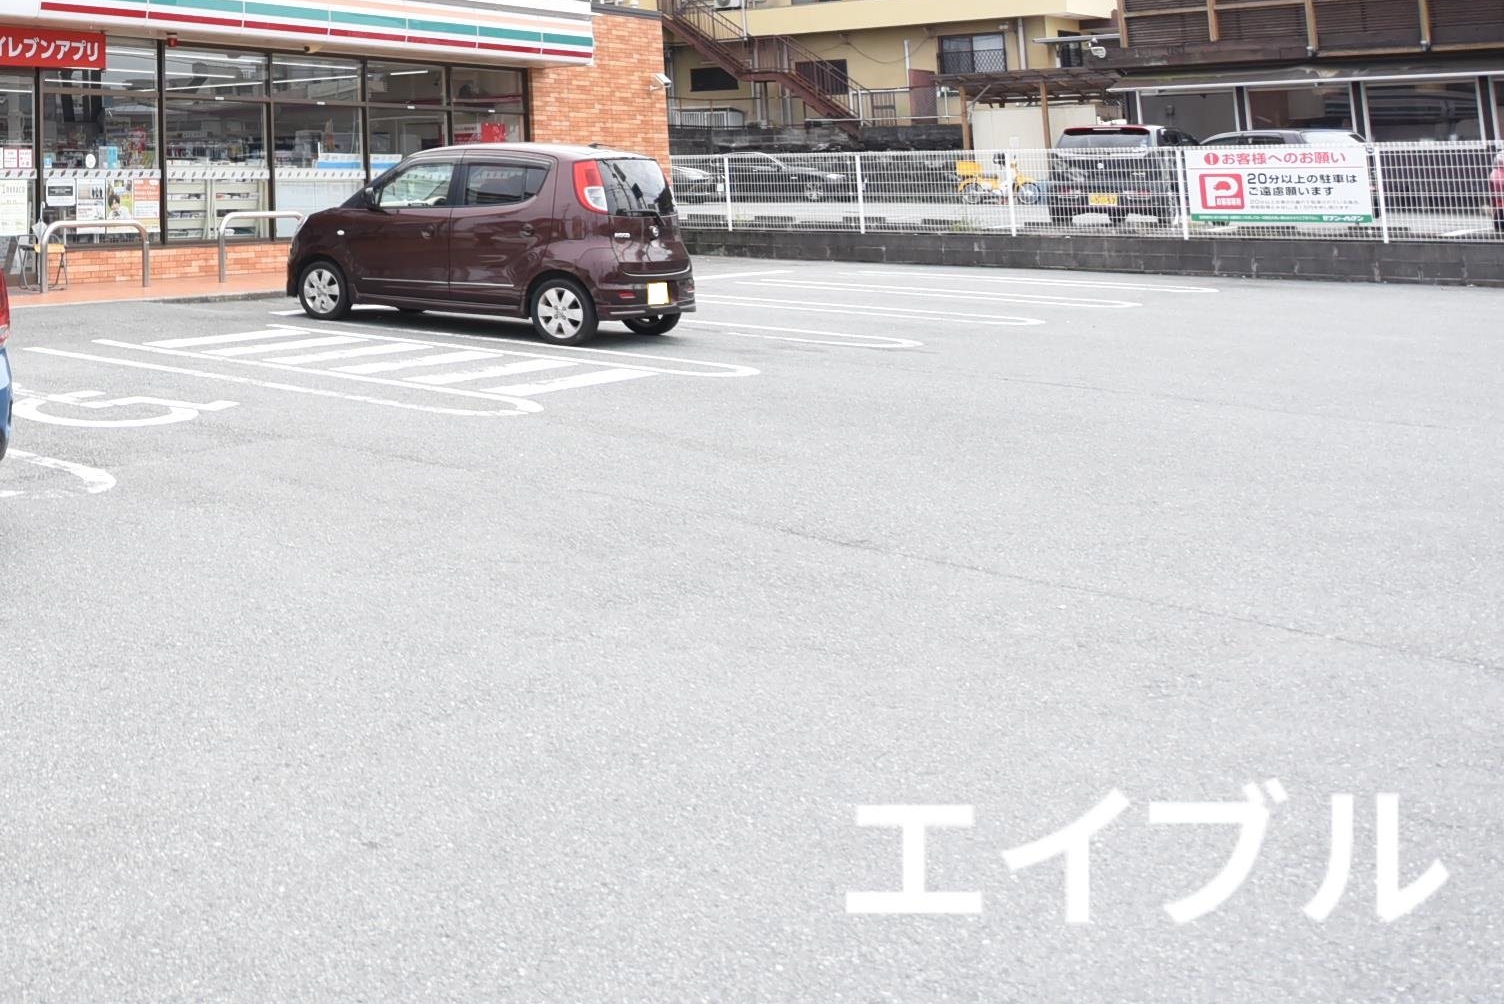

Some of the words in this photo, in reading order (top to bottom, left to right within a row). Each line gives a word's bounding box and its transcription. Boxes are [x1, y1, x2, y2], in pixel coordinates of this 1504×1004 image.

[1222, 151, 1347, 165] お客様へのお願い
[1247, 173, 1358, 184] 20分以上の駐車は
[1249, 186, 1334, 196] ご遠慮願います
